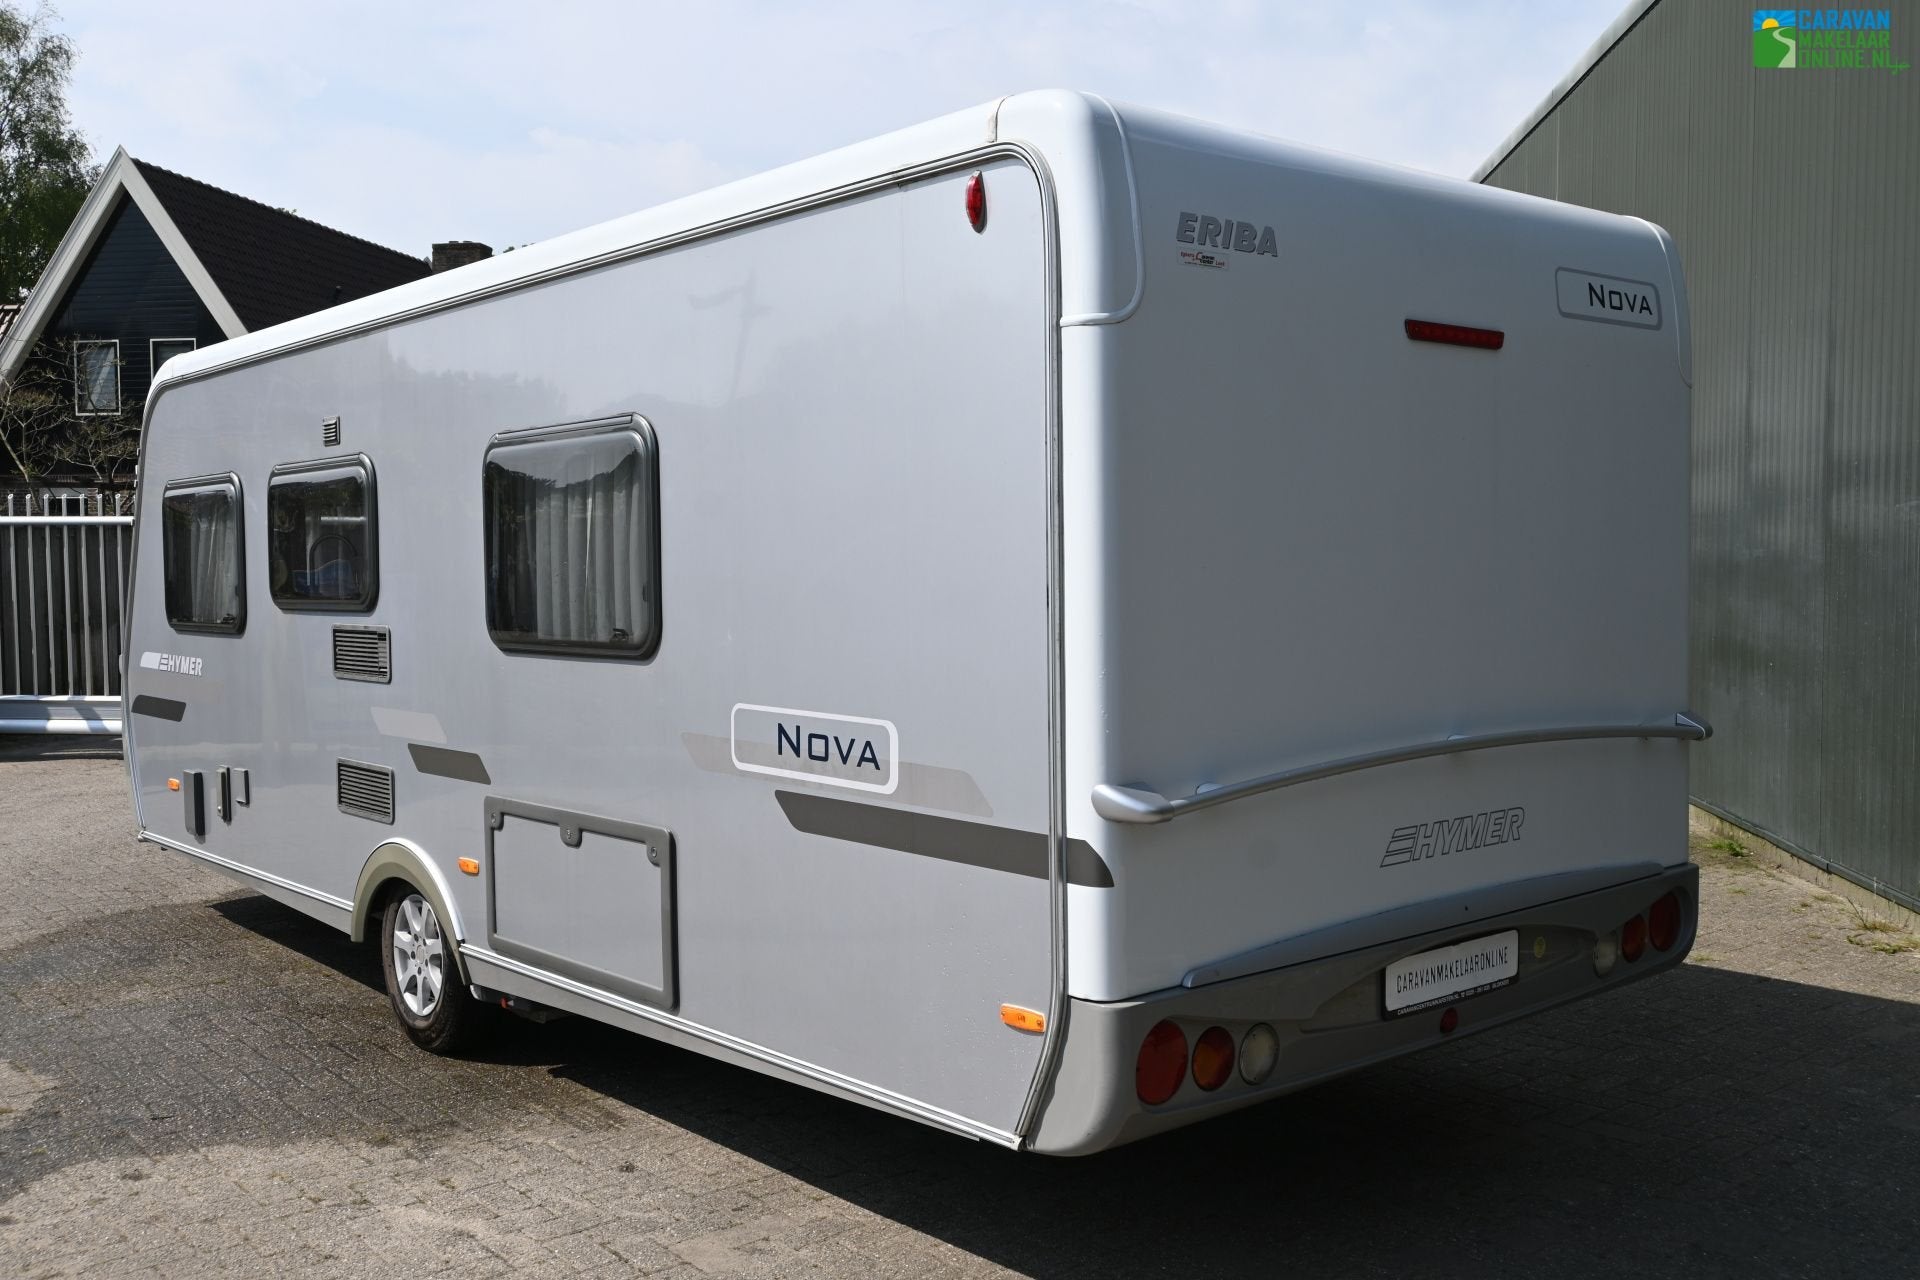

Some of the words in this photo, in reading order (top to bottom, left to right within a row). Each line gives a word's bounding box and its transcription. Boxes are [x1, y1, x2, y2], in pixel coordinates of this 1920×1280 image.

[1176, 211, 1279, 258] ERIBA
[167, 653, 203, 677] HYMER
[1410, 806, 1525, 862] HYMER
[1396, 946, 1509, 994] CARAVANMAKELAARONLINE
